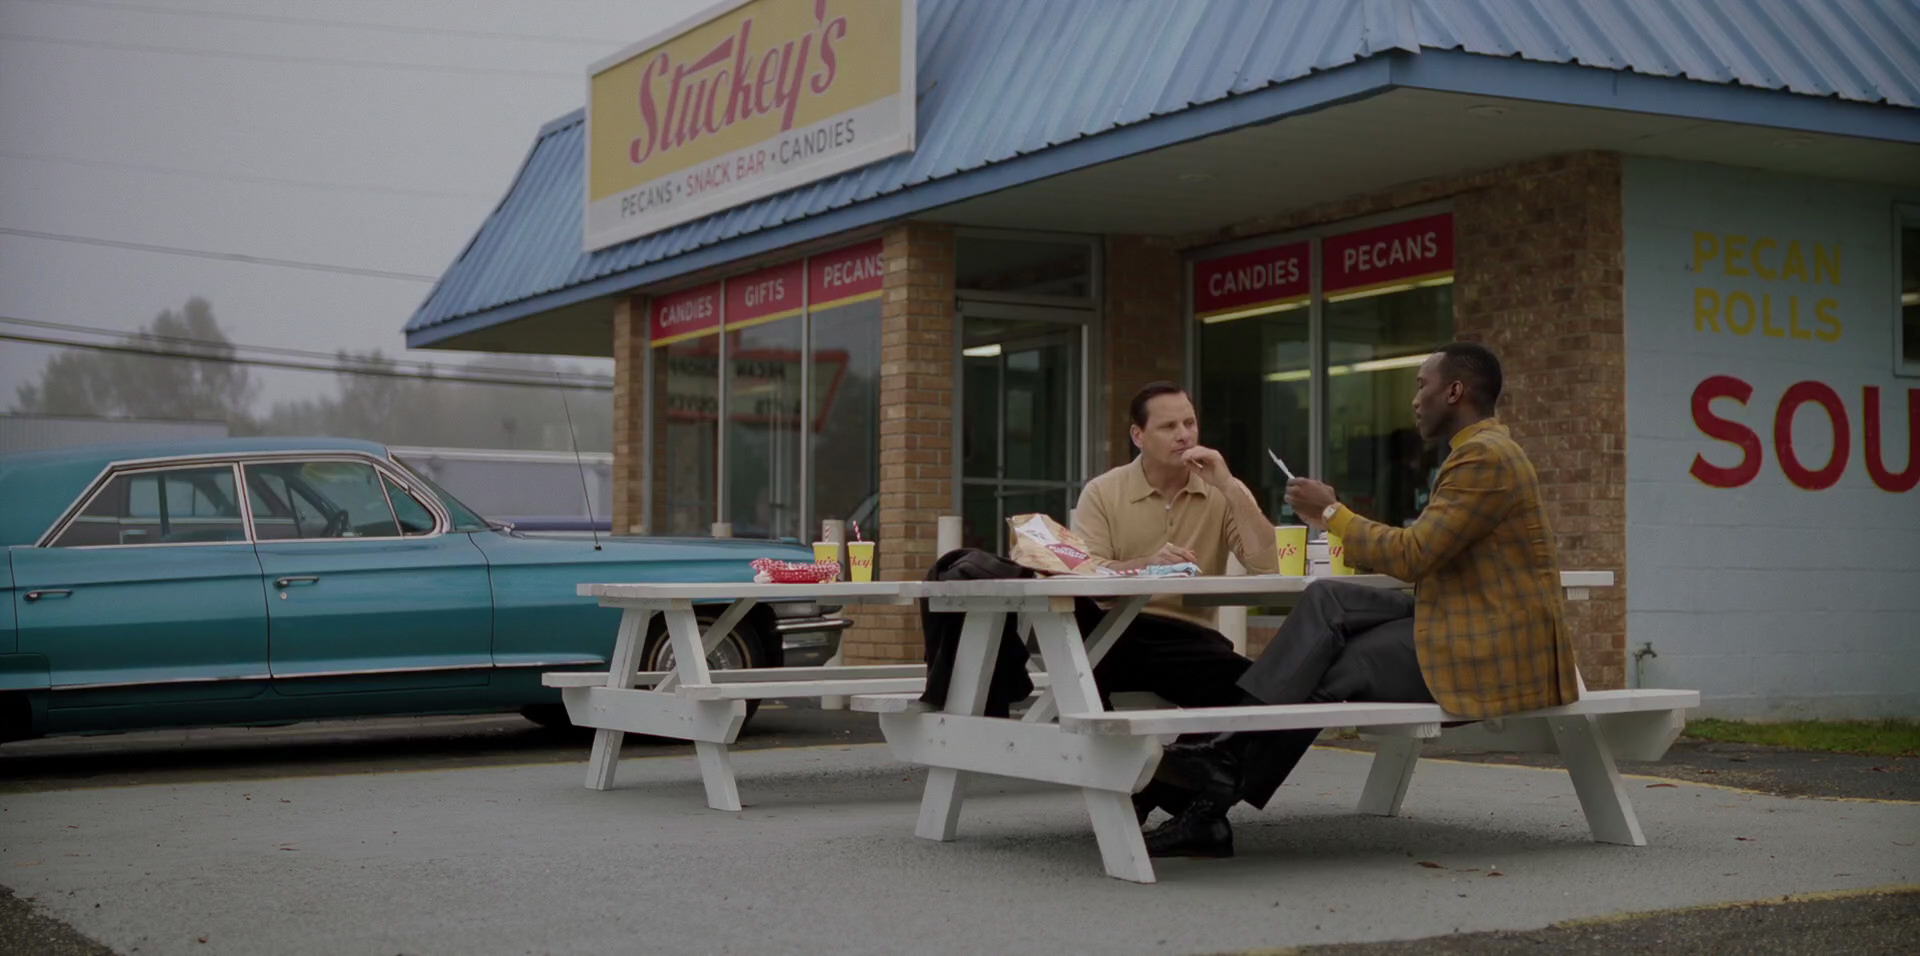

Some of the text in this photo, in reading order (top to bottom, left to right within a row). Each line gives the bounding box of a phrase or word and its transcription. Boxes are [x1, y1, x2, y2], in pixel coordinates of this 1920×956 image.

[630, 0, 847, 164] Stuckey's
[621, 118, 856, 218] PECANS SNACK BAR CANDIES
[823, 252, 884, 288] PECANS
[1208, 257, 1300, 297] CANDIES
[1343, 231, 1438, 274] PECANS
[1692, 231, 1842, 286] PECAN
[660, 295, 713, 328] CANDIES
[744, 278, 785, 307] GIFTS
[1694, 287, 1843, 342] ROLLS
[1690, 375, 1920, 493] SOU
